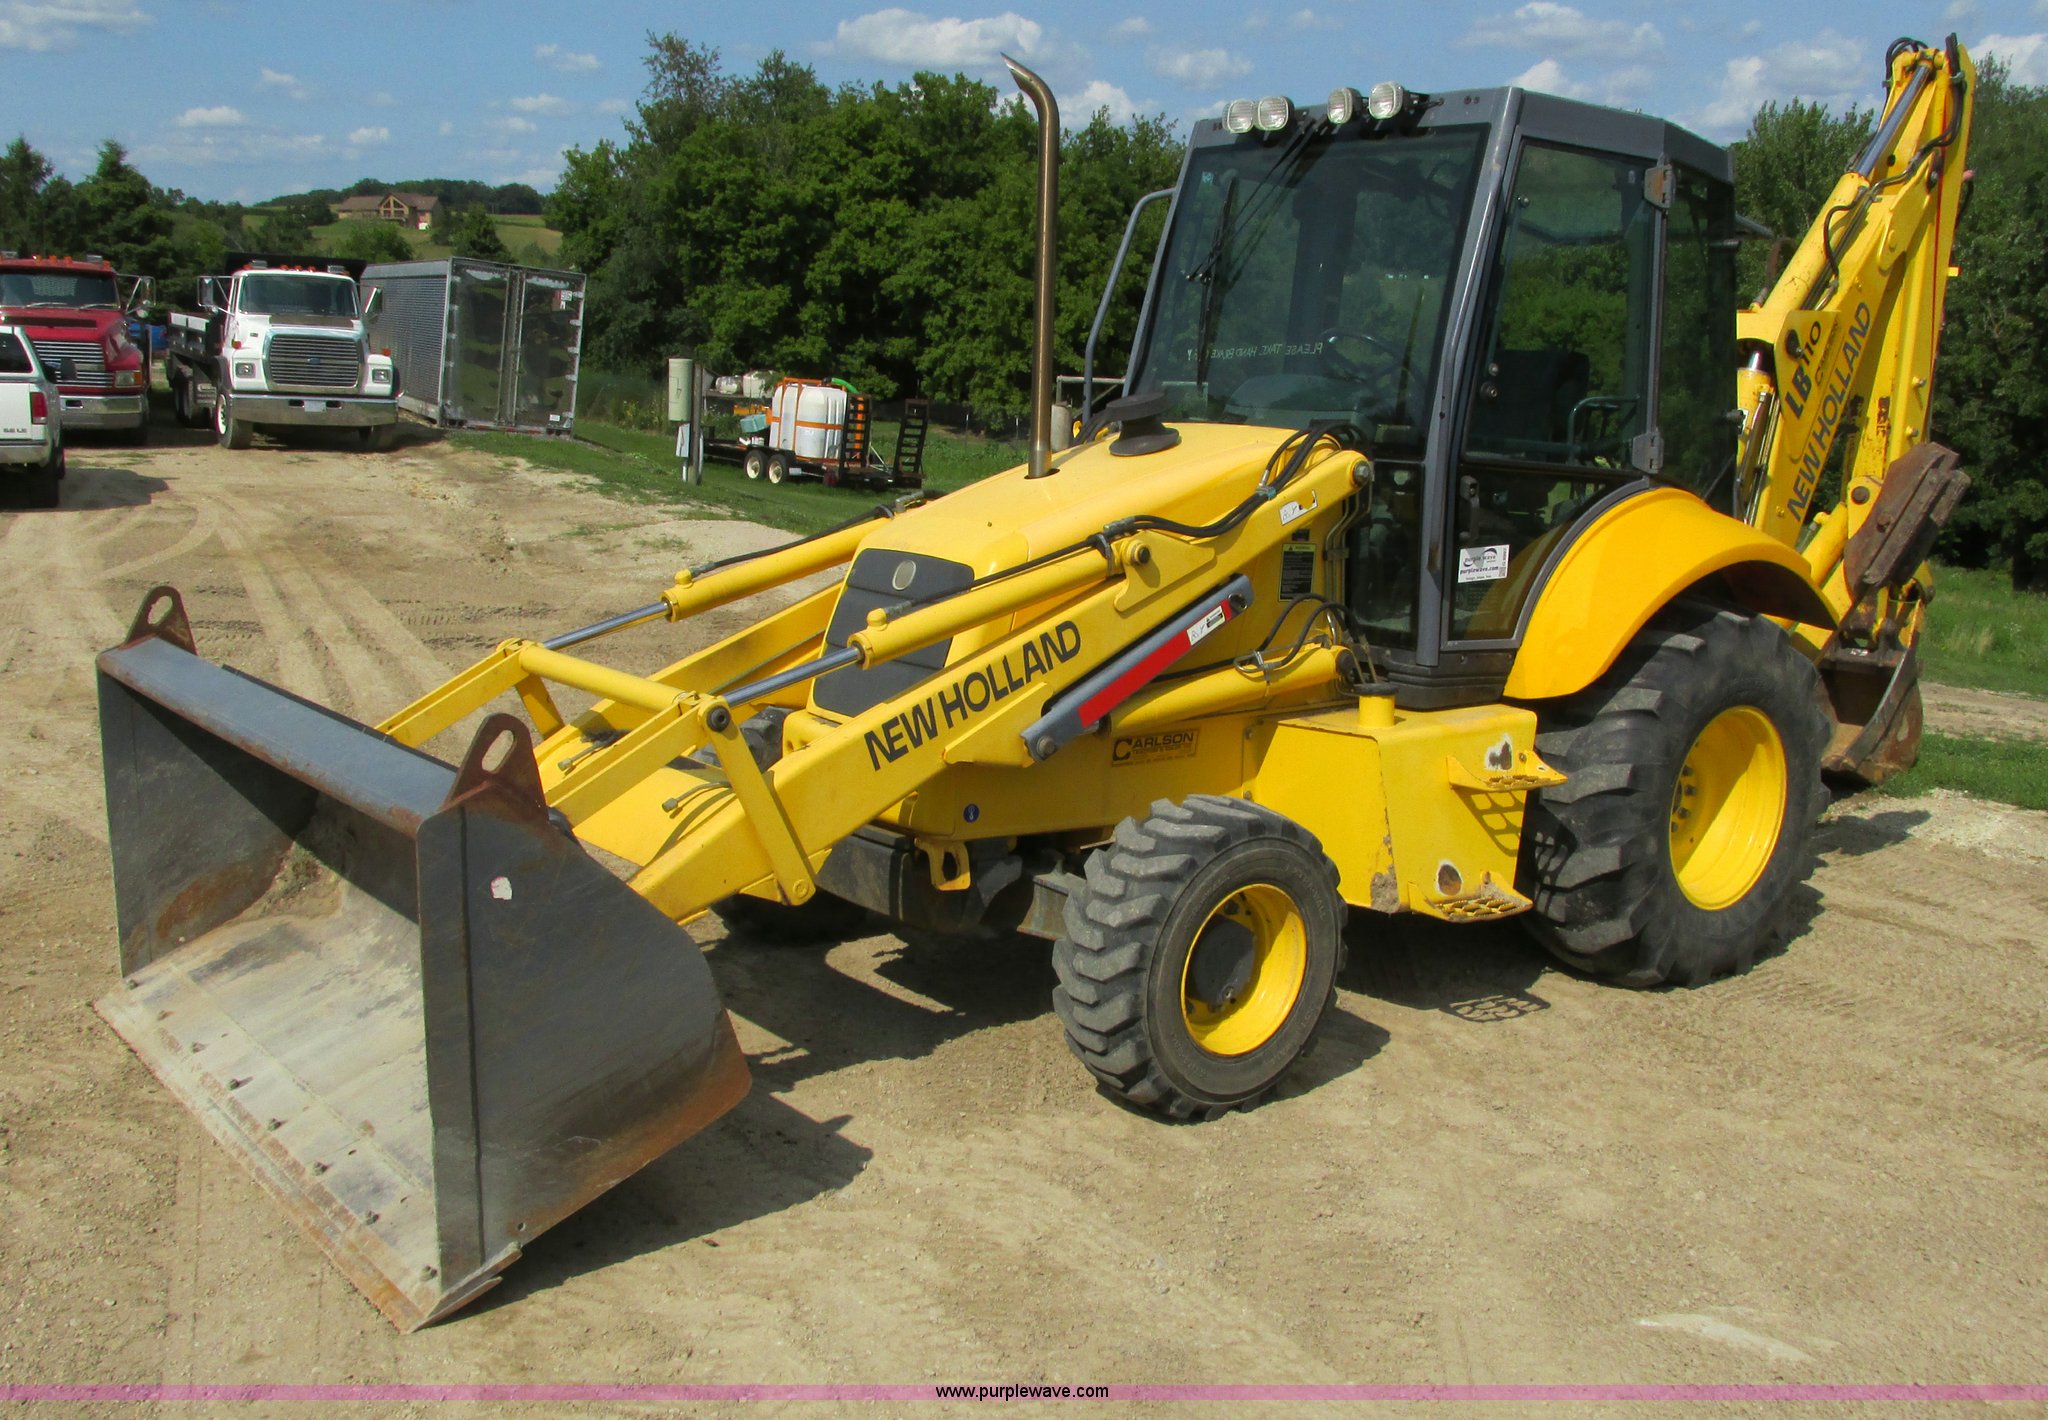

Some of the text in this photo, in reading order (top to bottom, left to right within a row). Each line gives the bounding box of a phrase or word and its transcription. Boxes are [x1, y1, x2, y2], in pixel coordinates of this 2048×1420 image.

[1787, 443, 1822, 522] NEW
[1812, 302, 1871, 450] HOLLAND
[864, 620, 1081, 772] NEW HOLLAND
